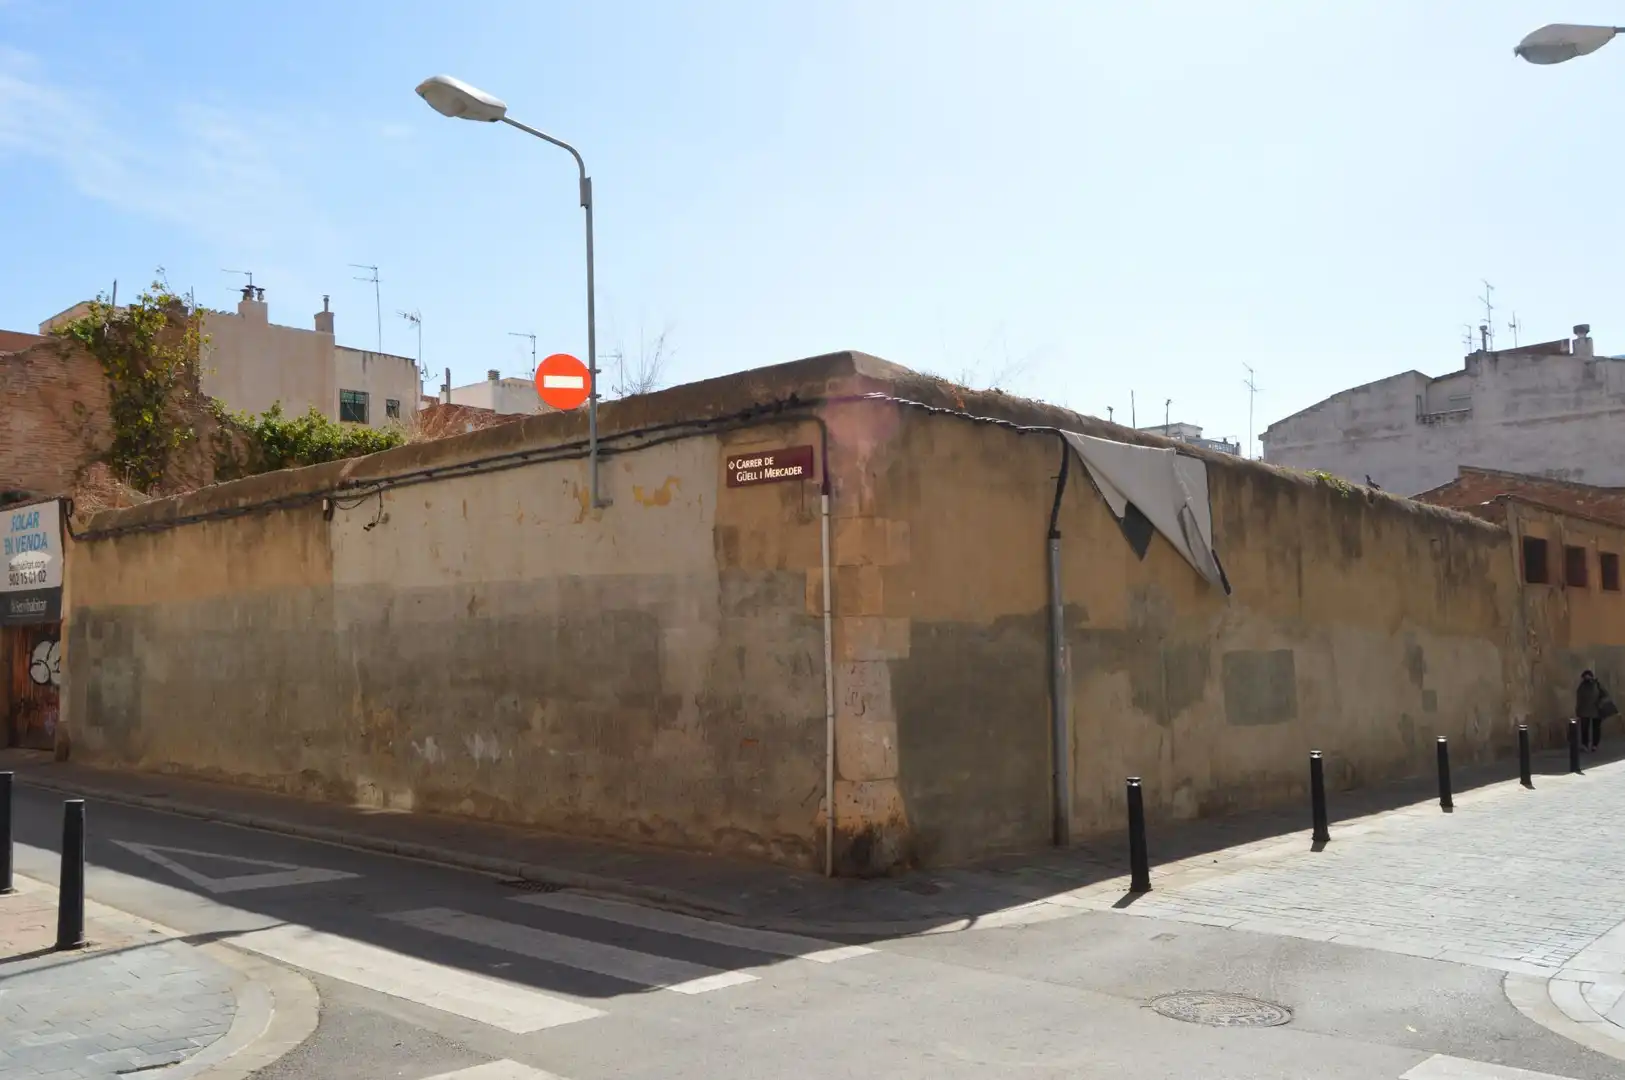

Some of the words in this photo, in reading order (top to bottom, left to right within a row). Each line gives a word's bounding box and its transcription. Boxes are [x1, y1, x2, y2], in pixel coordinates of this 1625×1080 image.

[736, 458, 762, 469] CARRER
[764, 456, 774, 466] DE
[737, 470, 757, 482] GÜELL
[764, 466, 803, 478] MERCADER
[11, 511, 40, 532] SOLAR
[4, 537, 13, 555] EN
[15, 532, 48, 553] VENDA
[8, 572, 19, 586] 902
[20, 572, 28, 585] 15
[38, 570, 47, 583] 02
